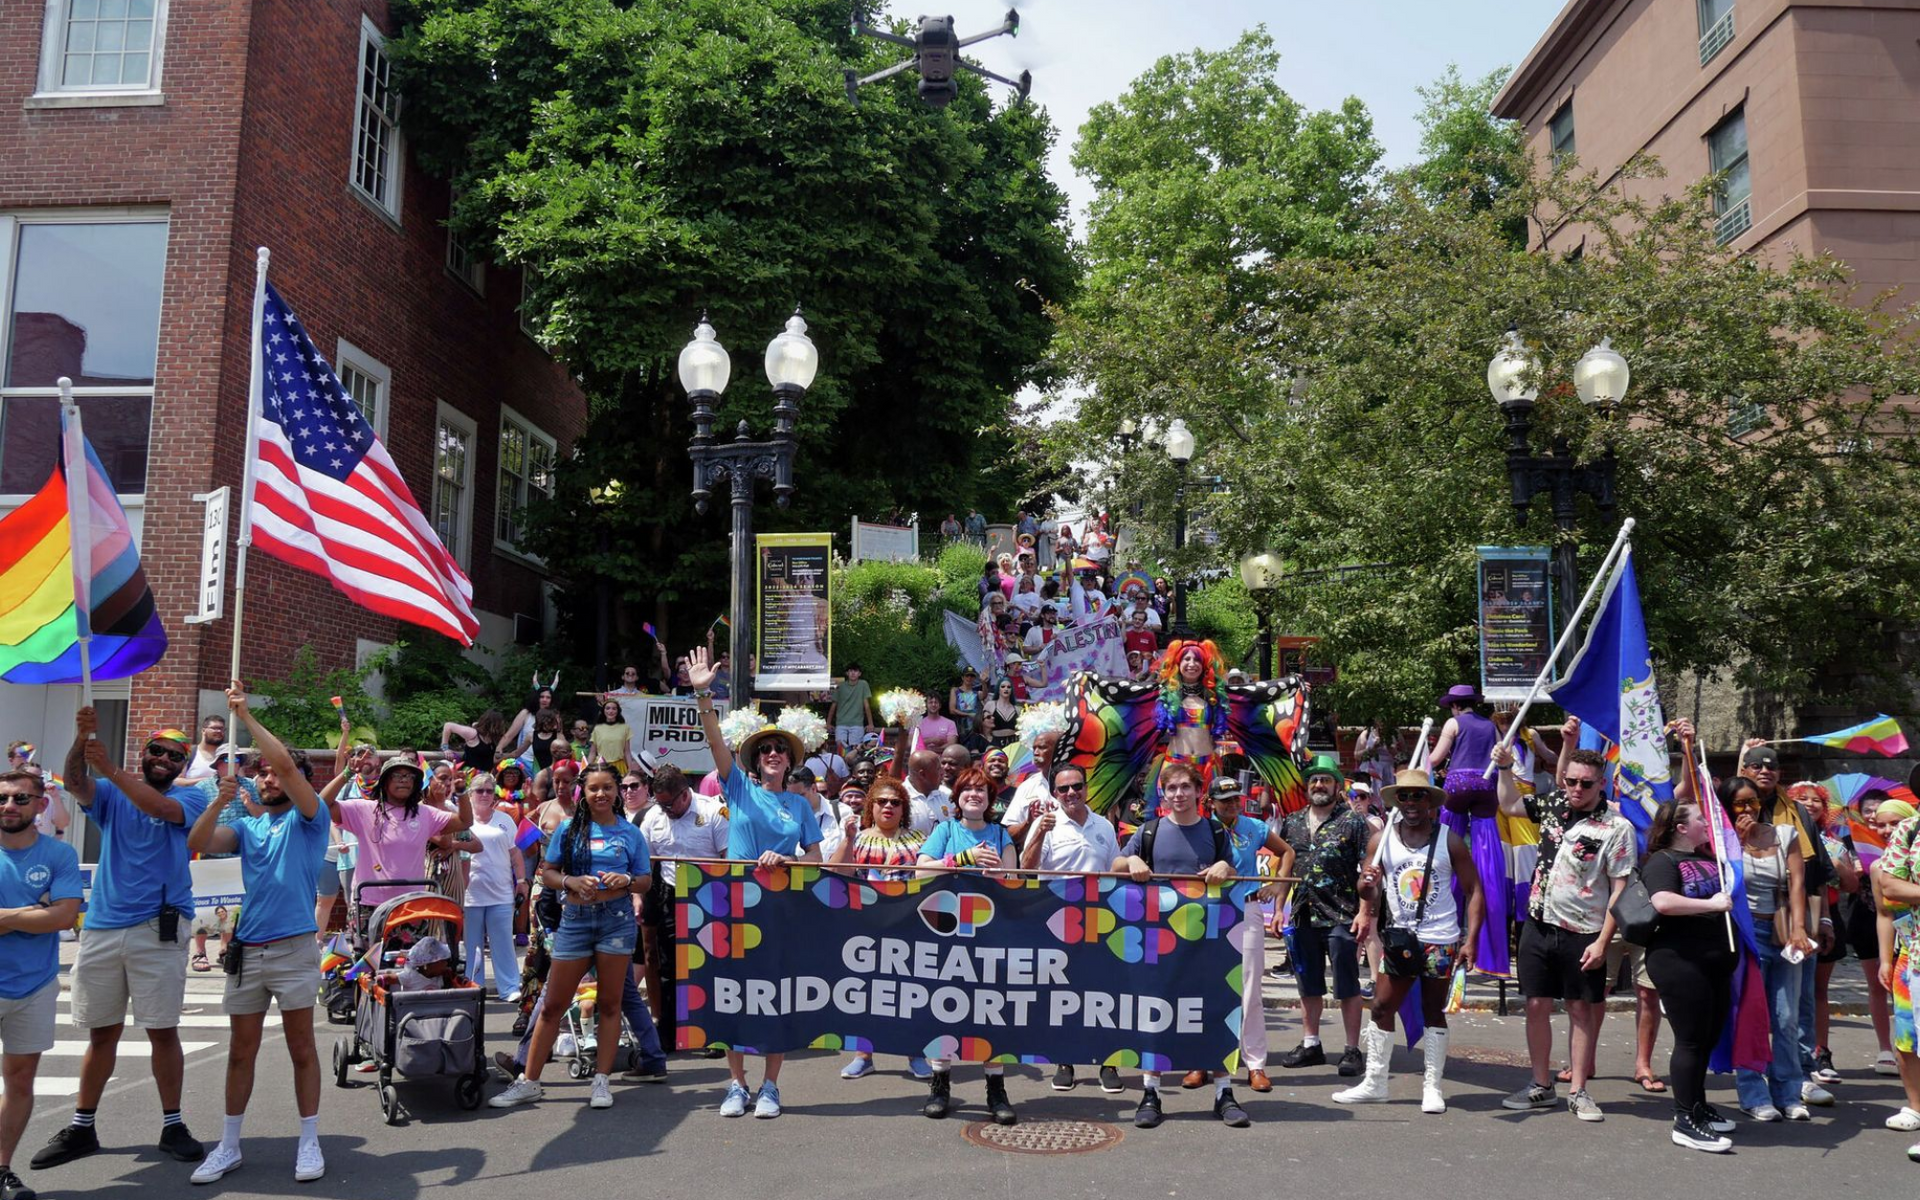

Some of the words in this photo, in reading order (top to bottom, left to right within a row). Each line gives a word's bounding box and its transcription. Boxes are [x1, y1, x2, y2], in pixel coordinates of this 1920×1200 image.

[649, 706, 719, 726] MILFO
[648, 729, 708, 743] PRID
[841, 935, 1070, 985] GREATER
[713, 976, 1036, 1026] BRIDGEPORT
[1048, 990, 1204, 1034] PRIDE
